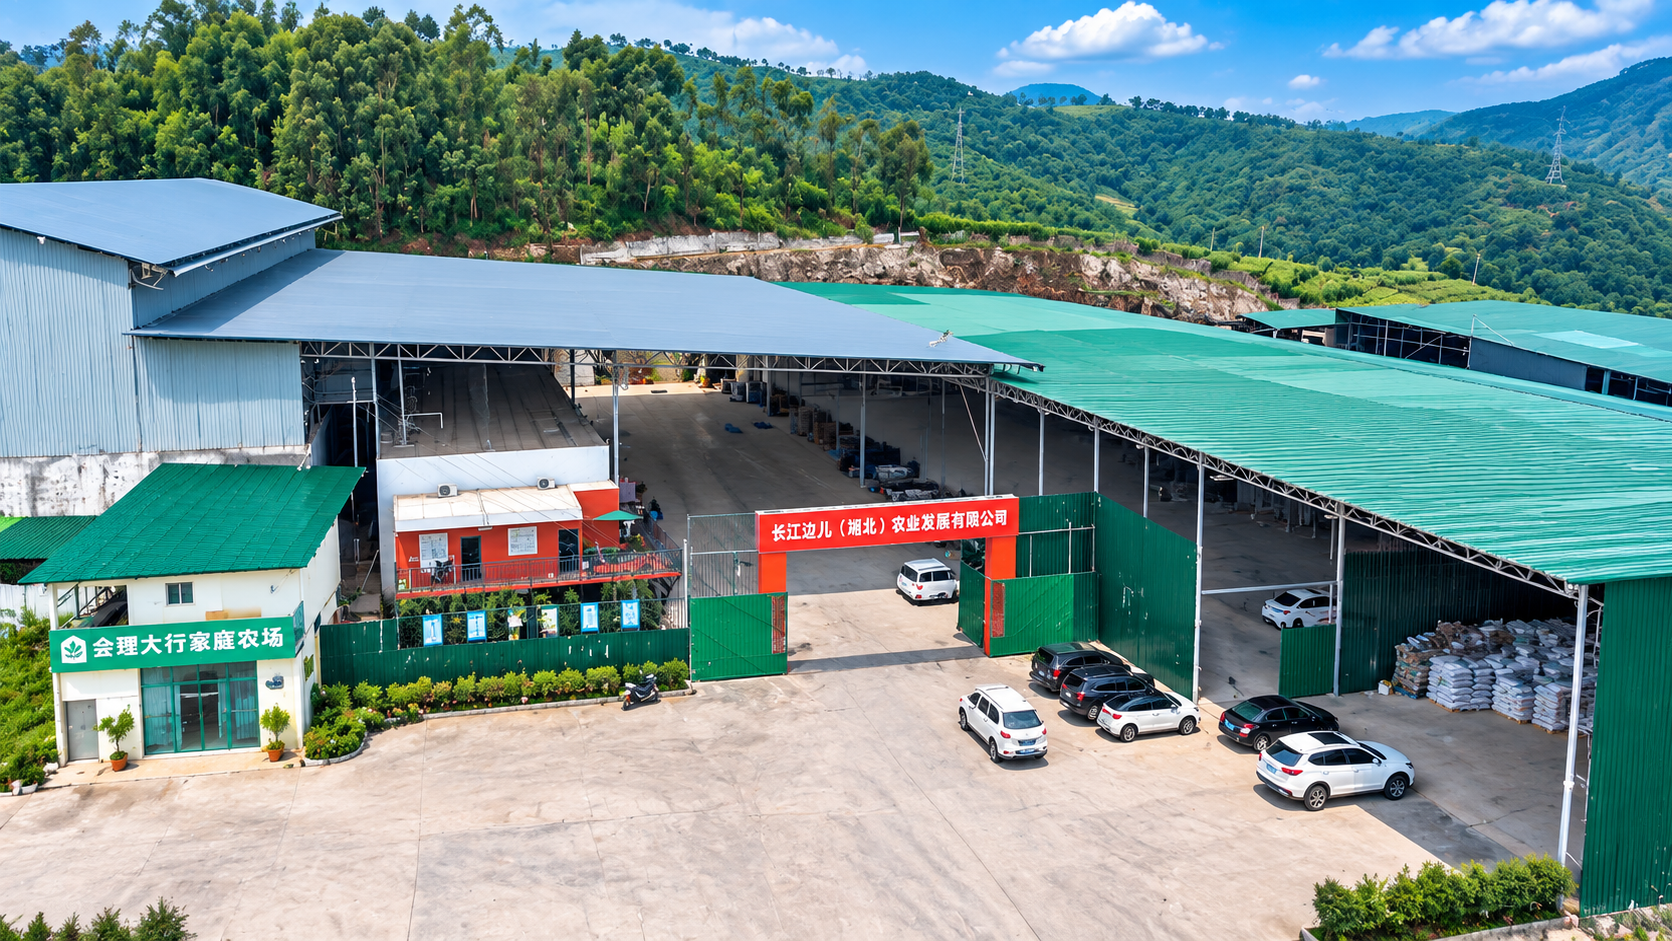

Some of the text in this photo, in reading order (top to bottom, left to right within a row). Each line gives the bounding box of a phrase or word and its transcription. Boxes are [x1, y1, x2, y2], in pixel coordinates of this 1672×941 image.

[92, 626, 284, 658] 会理大行家庭农场
